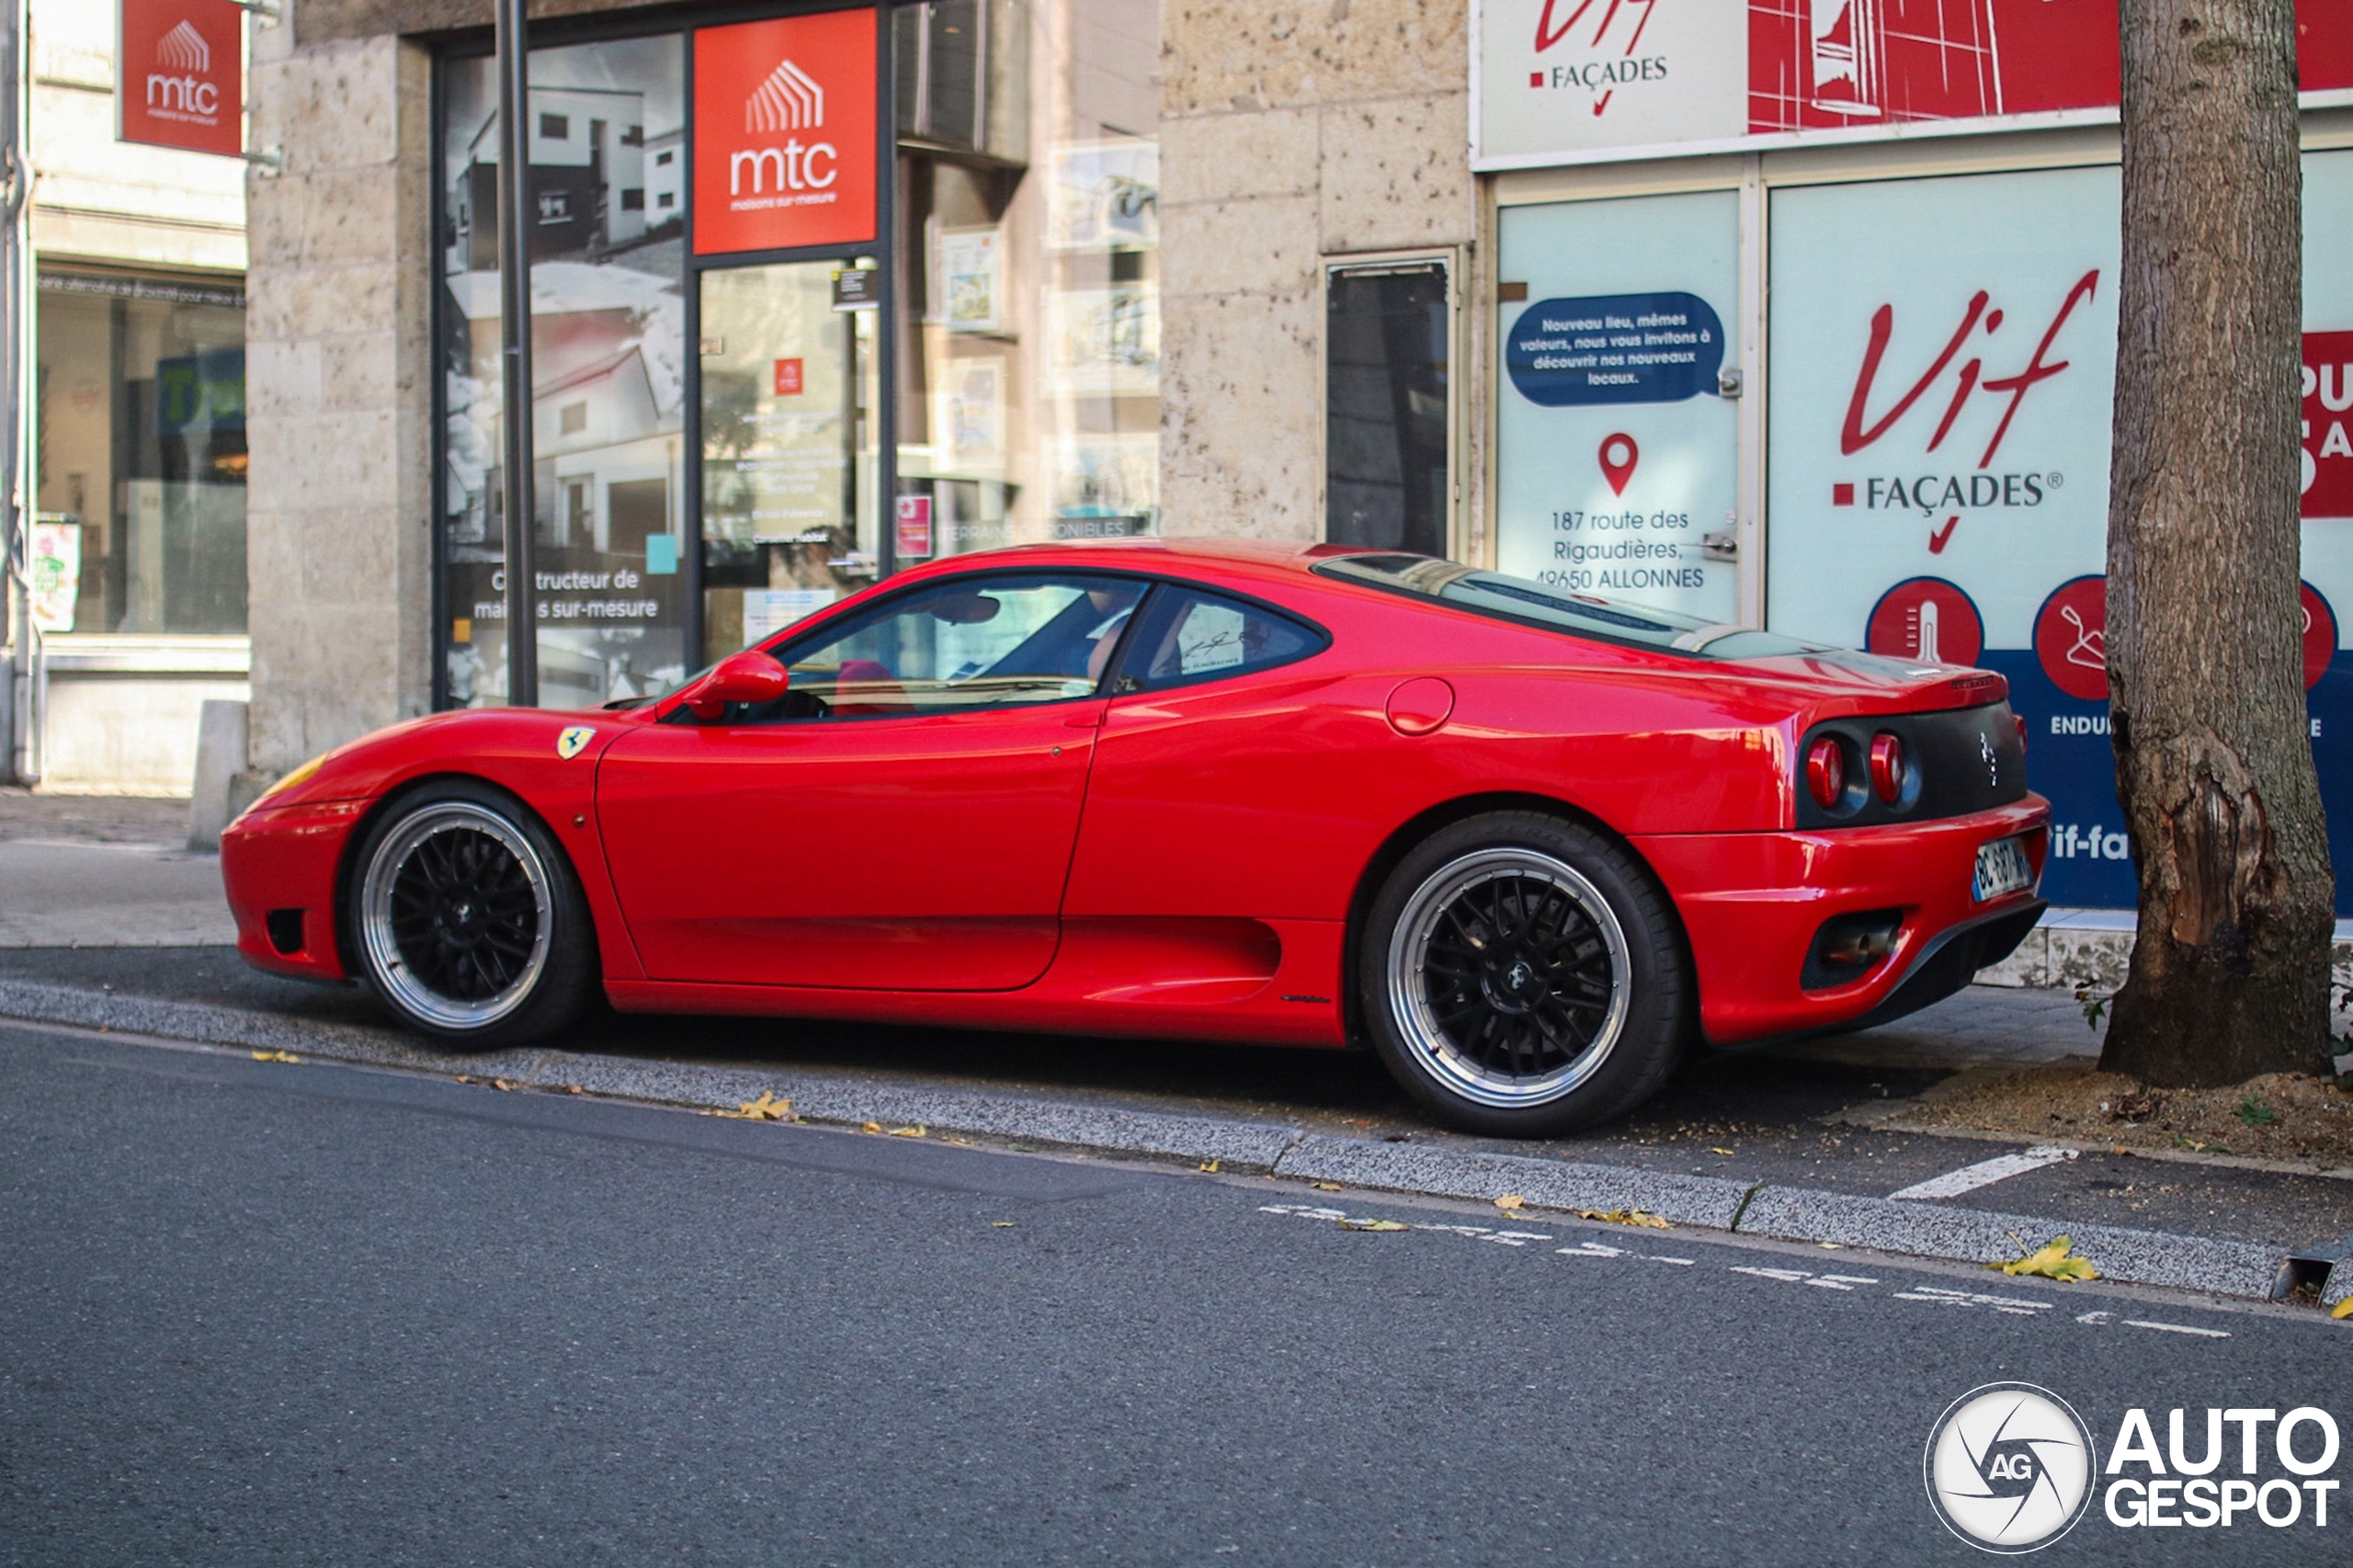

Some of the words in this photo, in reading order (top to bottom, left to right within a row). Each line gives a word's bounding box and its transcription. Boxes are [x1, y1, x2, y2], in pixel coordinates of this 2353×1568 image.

[1552, 56, 1668, 92] FAÇADES
[147, 74, 219, 115] mtc
[730, 138, 838, 196] mtc
[1542, 316, 1602, 333] Nouveau
[1604, 314, 1635, 332] lieu,
[1637, 312, 1688, 327] mêmes
[1519, 337, 1573, 352] valeurs,
[1574, 336, 1608, 350] nous
[1609, 334, 1642, 348] vous
[1643, 330, 1698, 347] invitons
[1699, 329, 1711, 344] à
[1533, 353, 1598, 369] découvrir
[1600, 354, 1625, 367] nos
[1627, 351, 1697, 365] nouveaux
[1841, 268, 2100, 470] Vif
[1587, 372, 1639, 386] locaux.
[1552, 511, 1585, 531] 187
[1591, 511, 1644, 530] route
[1651, 510, 1688, 529] des
[1553, 539, 1683, 564] Rigaudières,
[613, 568, 640, 588] de
[1598, 568, 1704, 589] ALLONNES
[551, 600, 658, 618] sur-mesure
